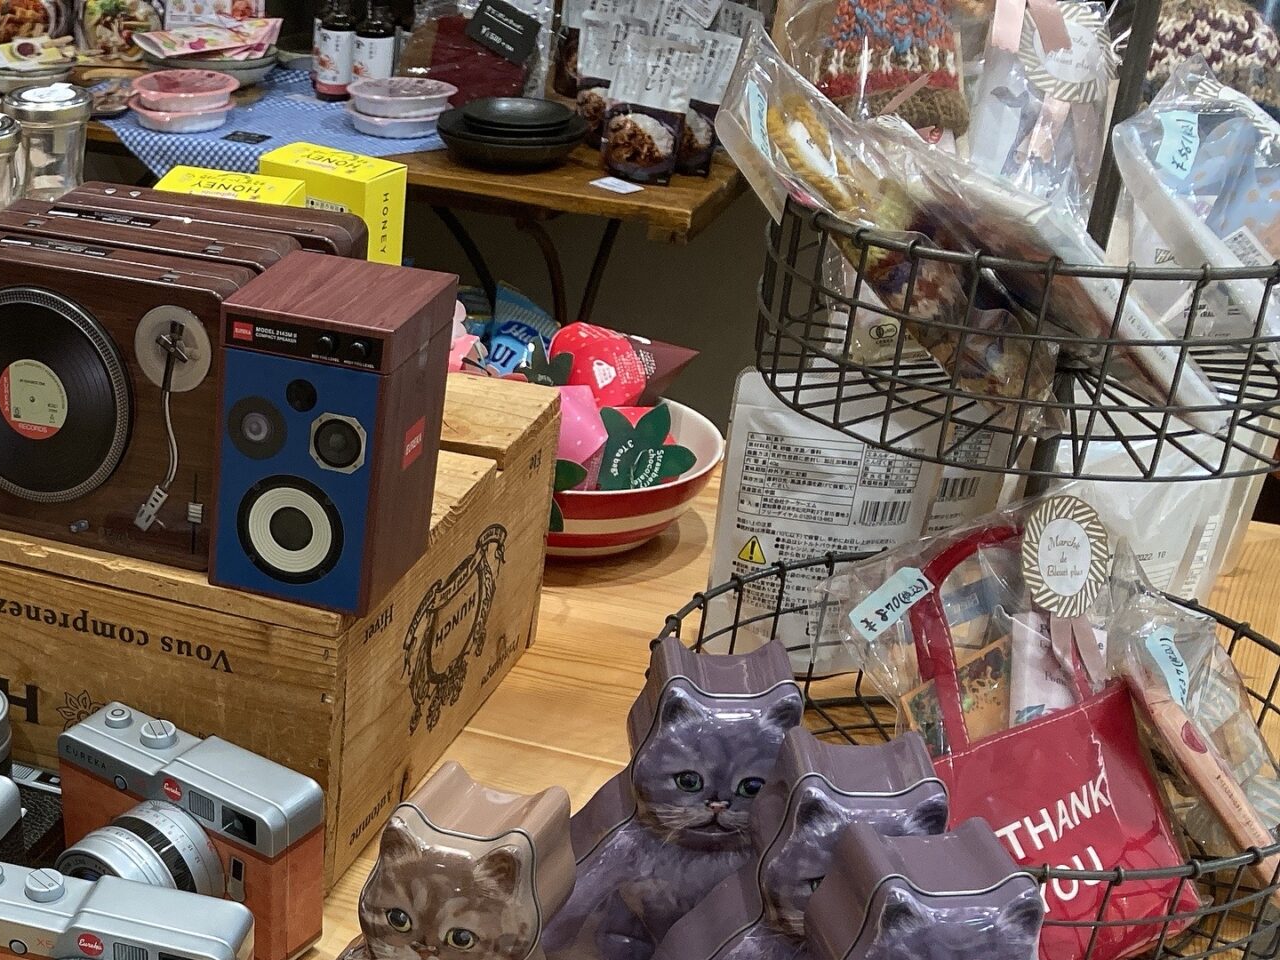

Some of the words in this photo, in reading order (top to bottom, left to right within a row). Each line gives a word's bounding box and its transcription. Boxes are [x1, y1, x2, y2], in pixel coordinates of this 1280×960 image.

[299, 152, 360, 170] HONEY
[191, 180, 261, 195] HONEY
[378, 192, 390, 255] HONEY
[255, 326, 276, 335] MODEL
[255, 332, 277, 341] COMPACT
[276, 336, 297, 344] SPEAKER
[18, 423, 48, 433] RECORDS
[1059, 551, 1068, 563] de
[362, 602, 395, 645] Hiver
[434, 590, 478, 648] HUNCH
[160, 634, 234, 674] Vous
[66, 744, 108, 769] EUREKA
[994, 770, 1111, 860] THANK
[77, 938, 105, 953] Eureka
